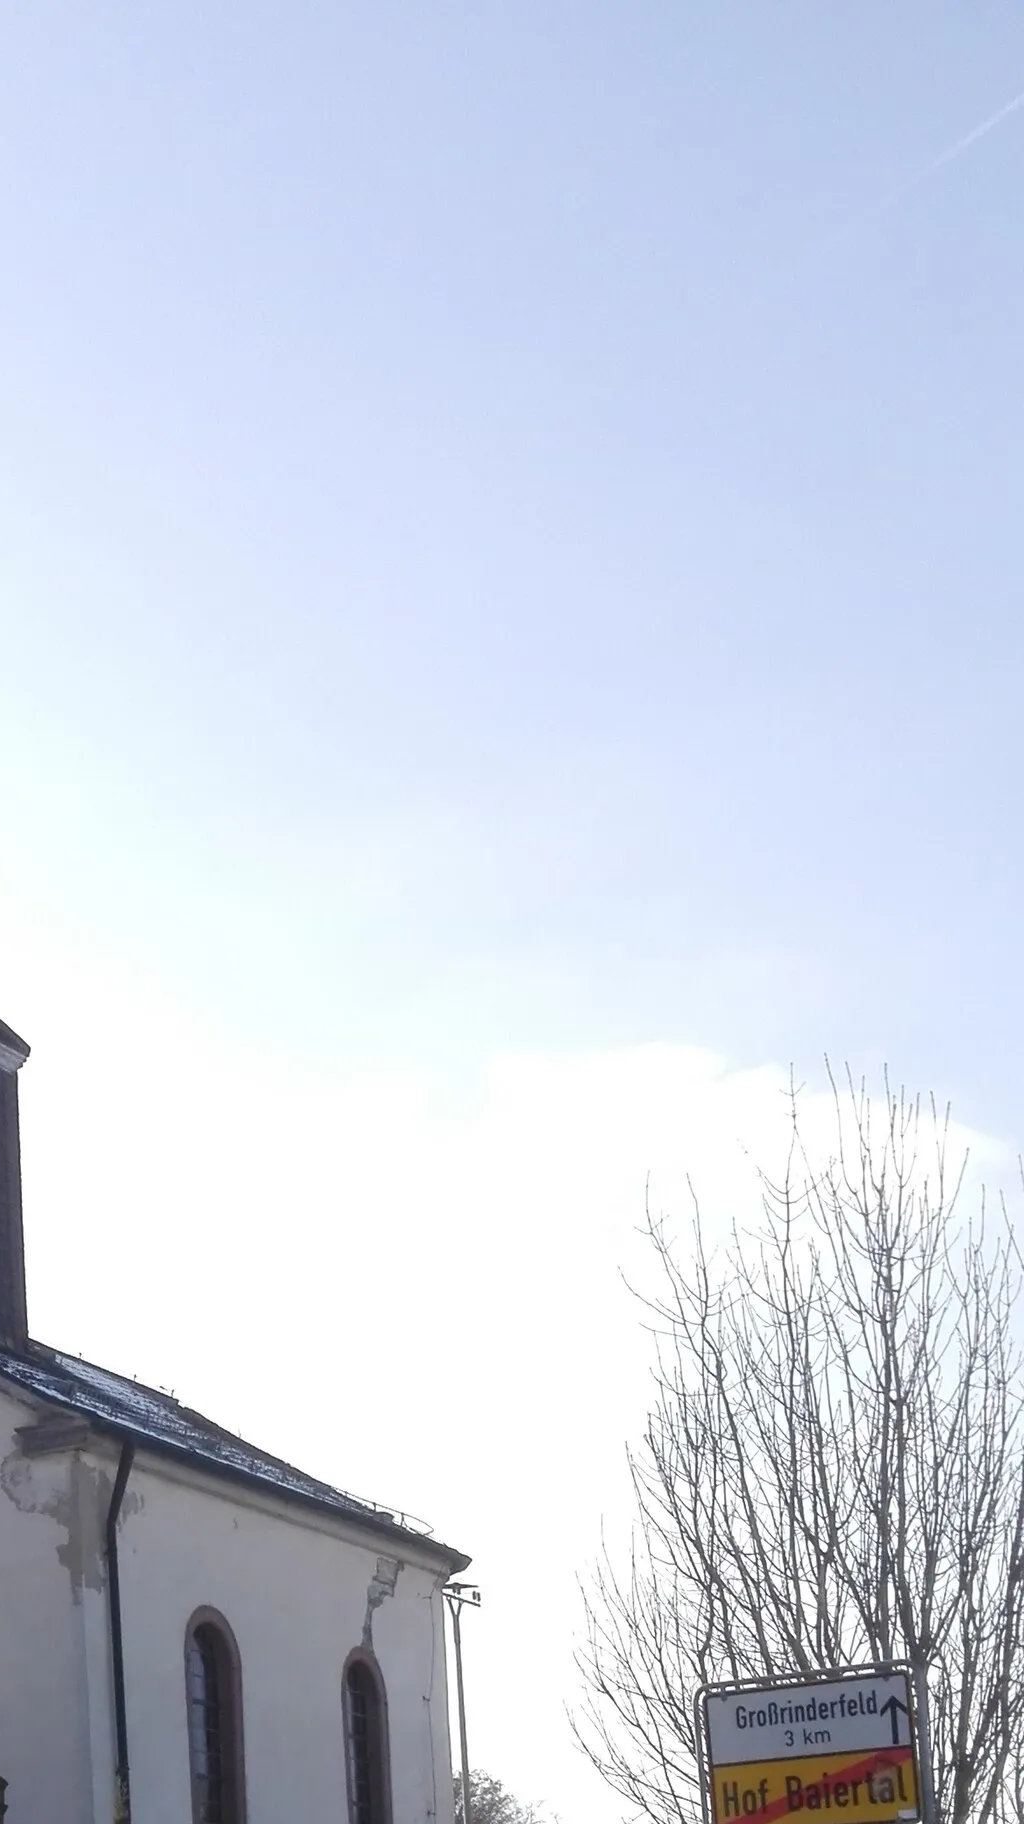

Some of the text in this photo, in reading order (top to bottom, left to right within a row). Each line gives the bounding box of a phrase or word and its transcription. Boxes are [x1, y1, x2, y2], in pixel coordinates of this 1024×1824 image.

[736, 1690, 878, 1729] Großrinderfeld
[785, 1728, 831, 1747] 3 km
[722, 1765, 908, 1817] Hof Baiertal
